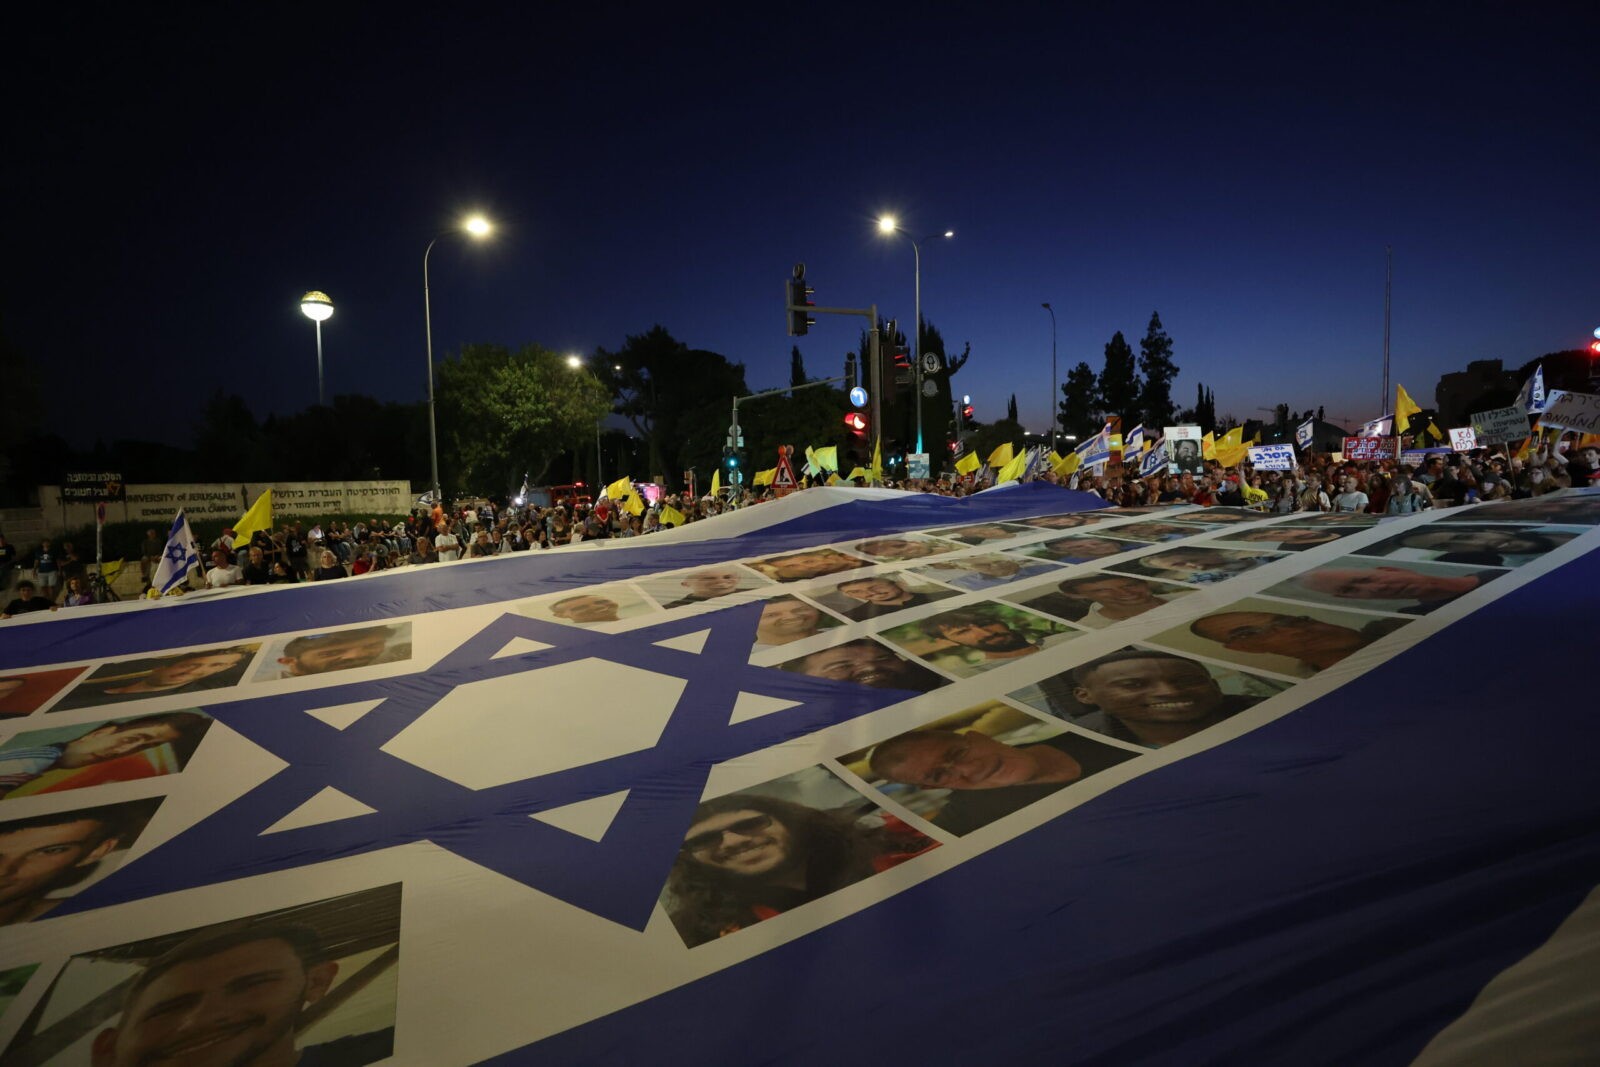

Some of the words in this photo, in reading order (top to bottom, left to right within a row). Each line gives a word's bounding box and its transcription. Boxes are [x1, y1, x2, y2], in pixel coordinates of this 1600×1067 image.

[1254, 451, 1292, 460] מסרב
[271, 489, 304, 499] בירושל
[308, 489, 342, 498] העברית
[346, 487, 400, 497] האוניברסיטה
[125, 494, 175, 503] UNIVERSITY
[177, 493, 185, 501] of
[188, 492, 236, 501] JERUSALEM
[141, 508, 175, 517] EDMOND
[208, 505, 238, 513] CAMPUS
